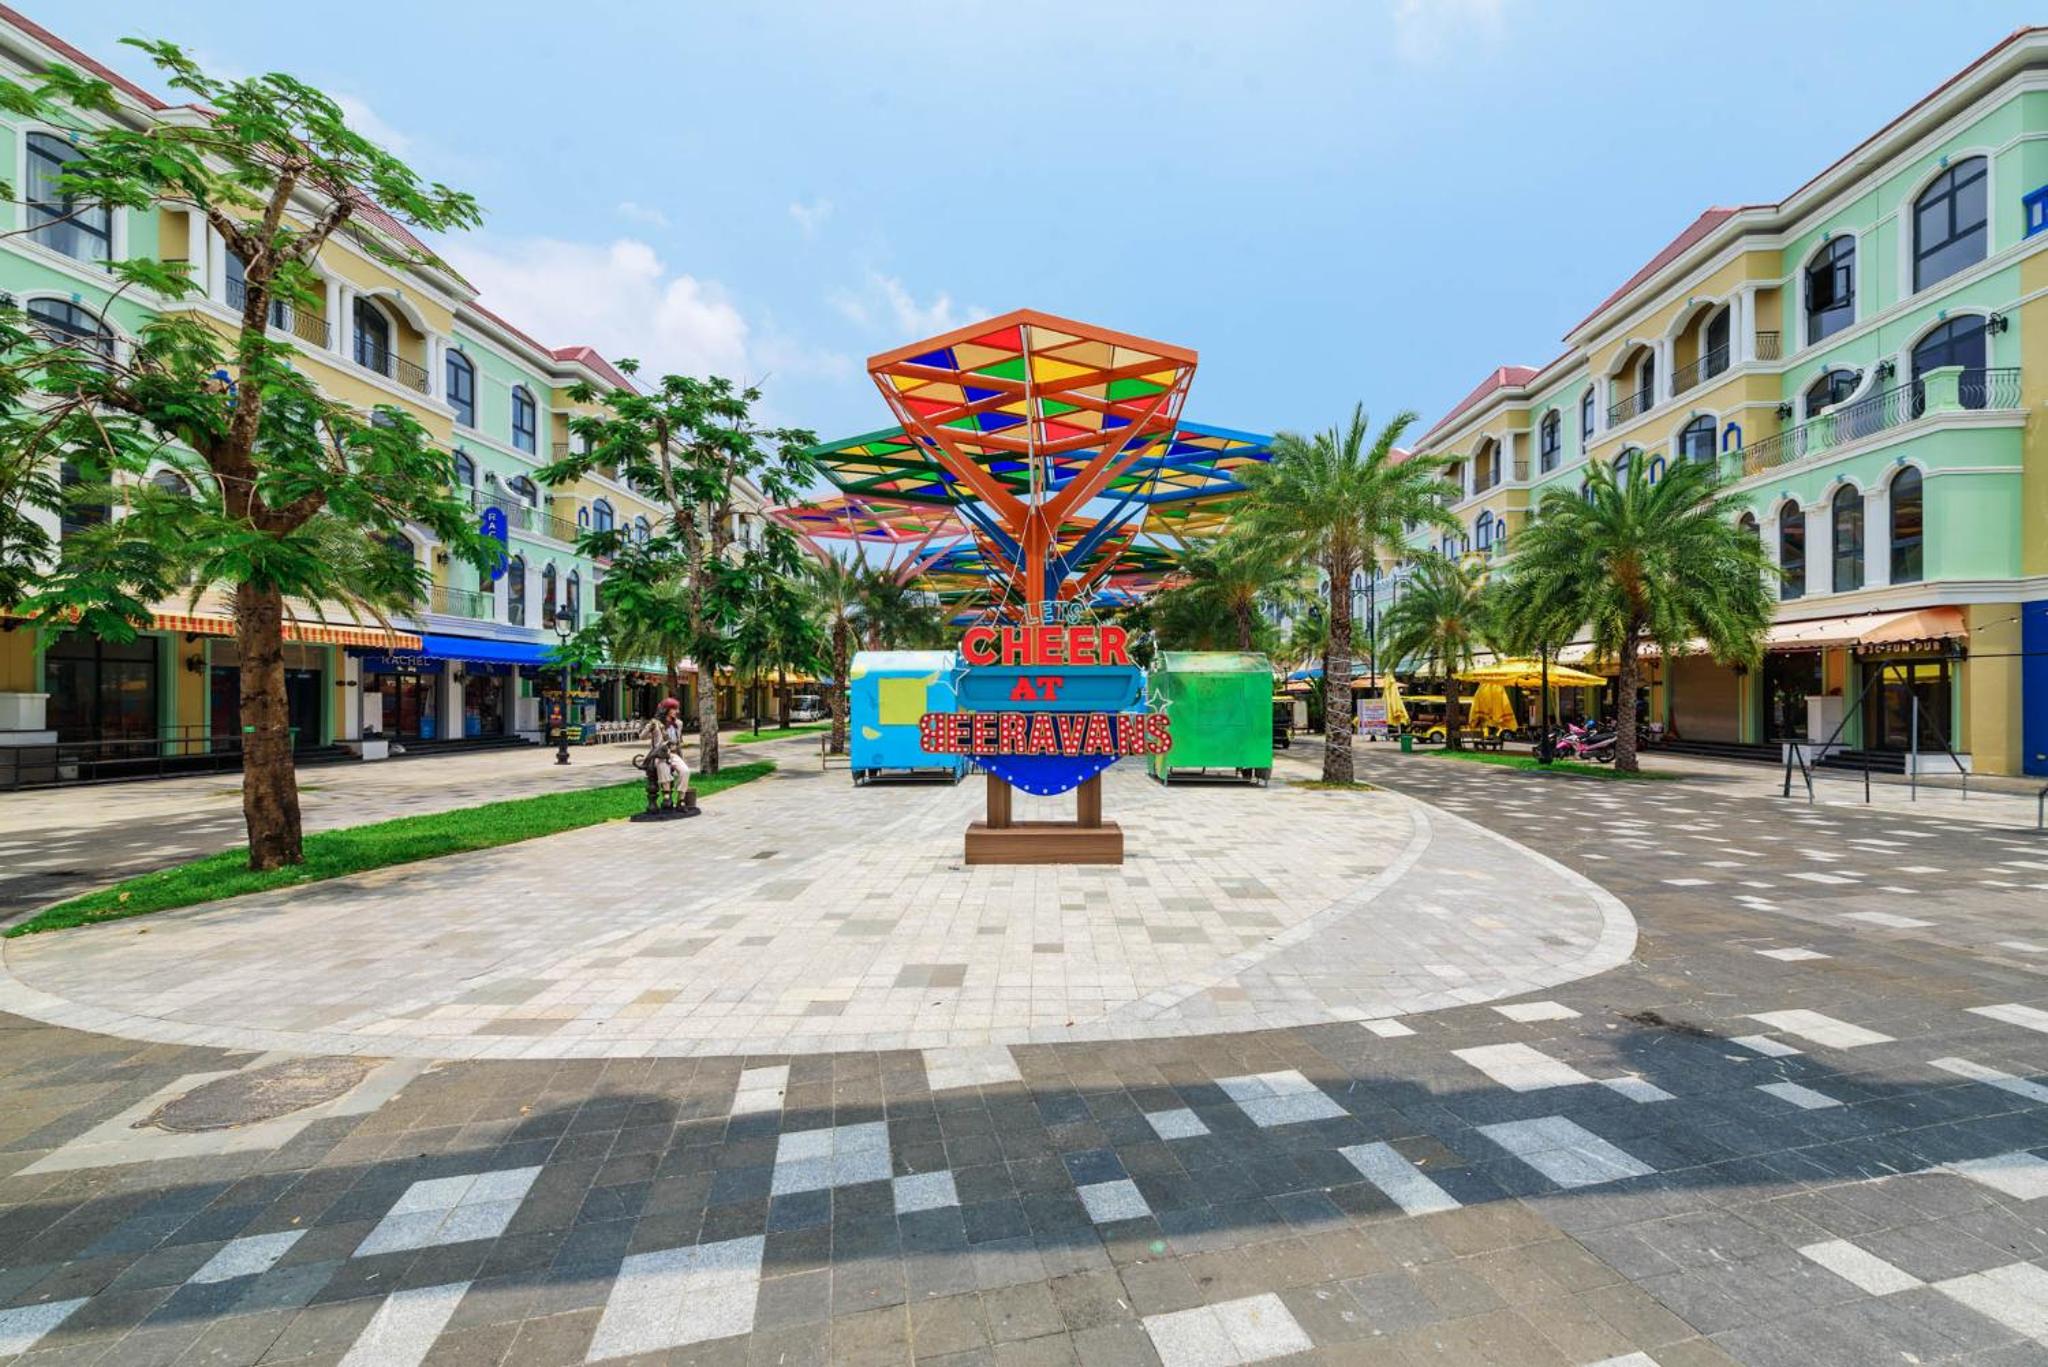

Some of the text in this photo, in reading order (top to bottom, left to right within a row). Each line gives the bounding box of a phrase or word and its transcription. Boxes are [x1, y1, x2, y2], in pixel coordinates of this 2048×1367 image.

[381, 655, 431, 666] RACHEL
[961, 624, 1133, 666] CHEER
[1009, 676, 1064, 701] AT
[919, 712, 1172, 756] BEERAVANS
